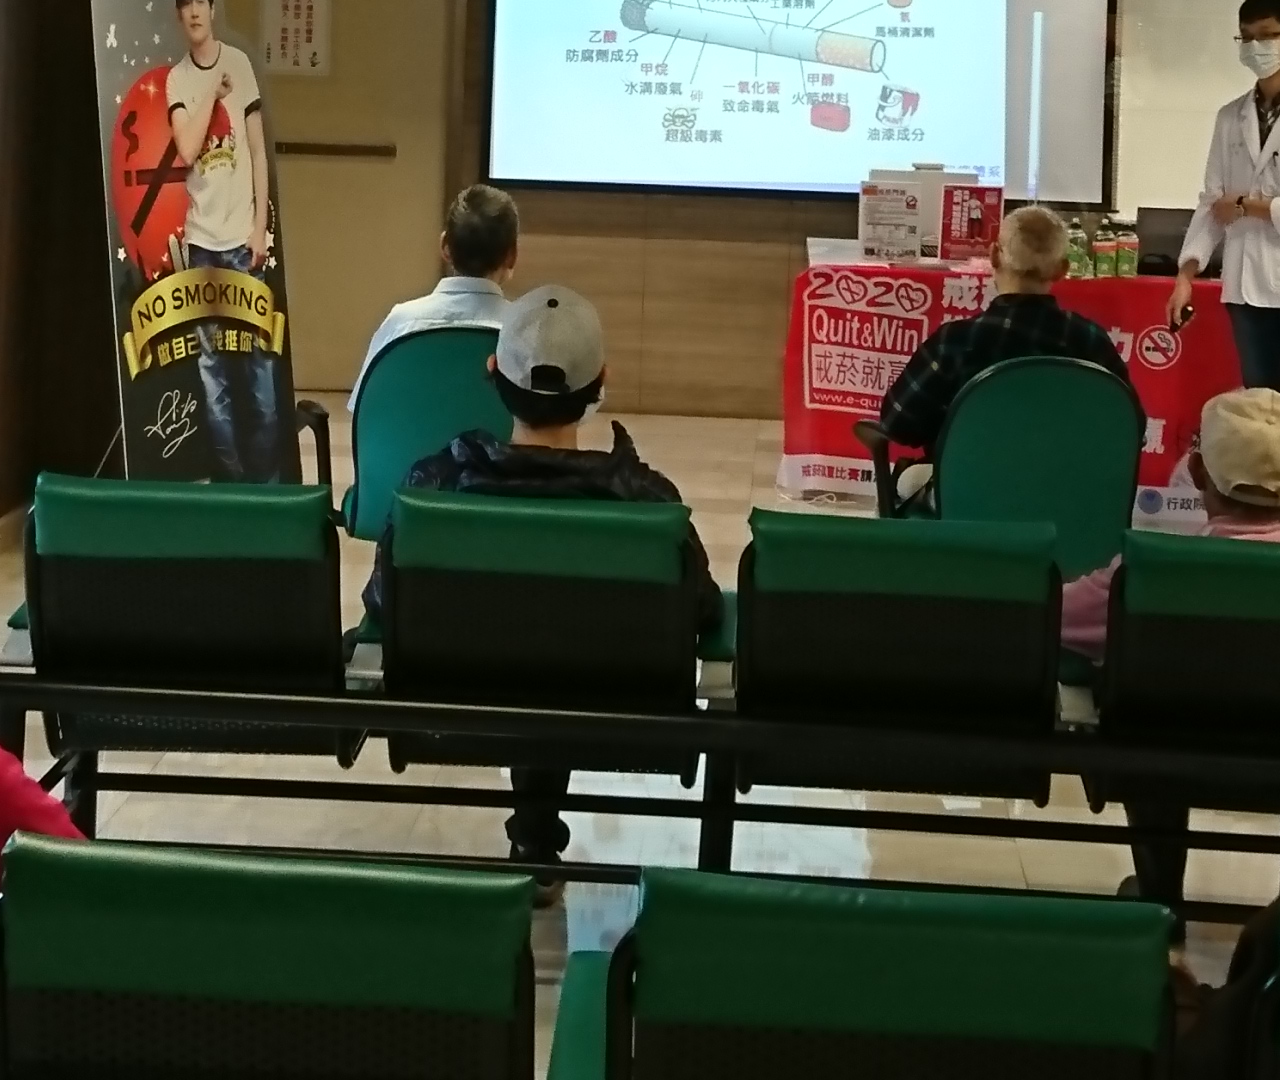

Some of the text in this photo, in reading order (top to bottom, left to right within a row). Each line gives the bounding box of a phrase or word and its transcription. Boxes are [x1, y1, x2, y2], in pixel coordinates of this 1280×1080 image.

[589, 29, 618, 44] 乙酸
[875, 27, 935, 38] 馬桶清潔劑
[565, 48, 639, 63] 防腐劑成分
[641, 63, 669, 76] 甲烷
[807, 73, 835, 87] 甲醇
[625, 81, 683, 96] 水溝廢氣
[723, 81, 781, 95] 一氧化碳
[722, 99, 780, 114] 致命毒氣
[665, 128, 723, 143] 超級毒素
[867, 127, 925, 142] 油漆成分
[137, 282, 268, 329] NO SMOKING
[812, 308, 918, 353] Quit&Win
[157, 332, 200, 367] 做自己
[801, 464, 877, 483] 戒菸就贏比賽請
